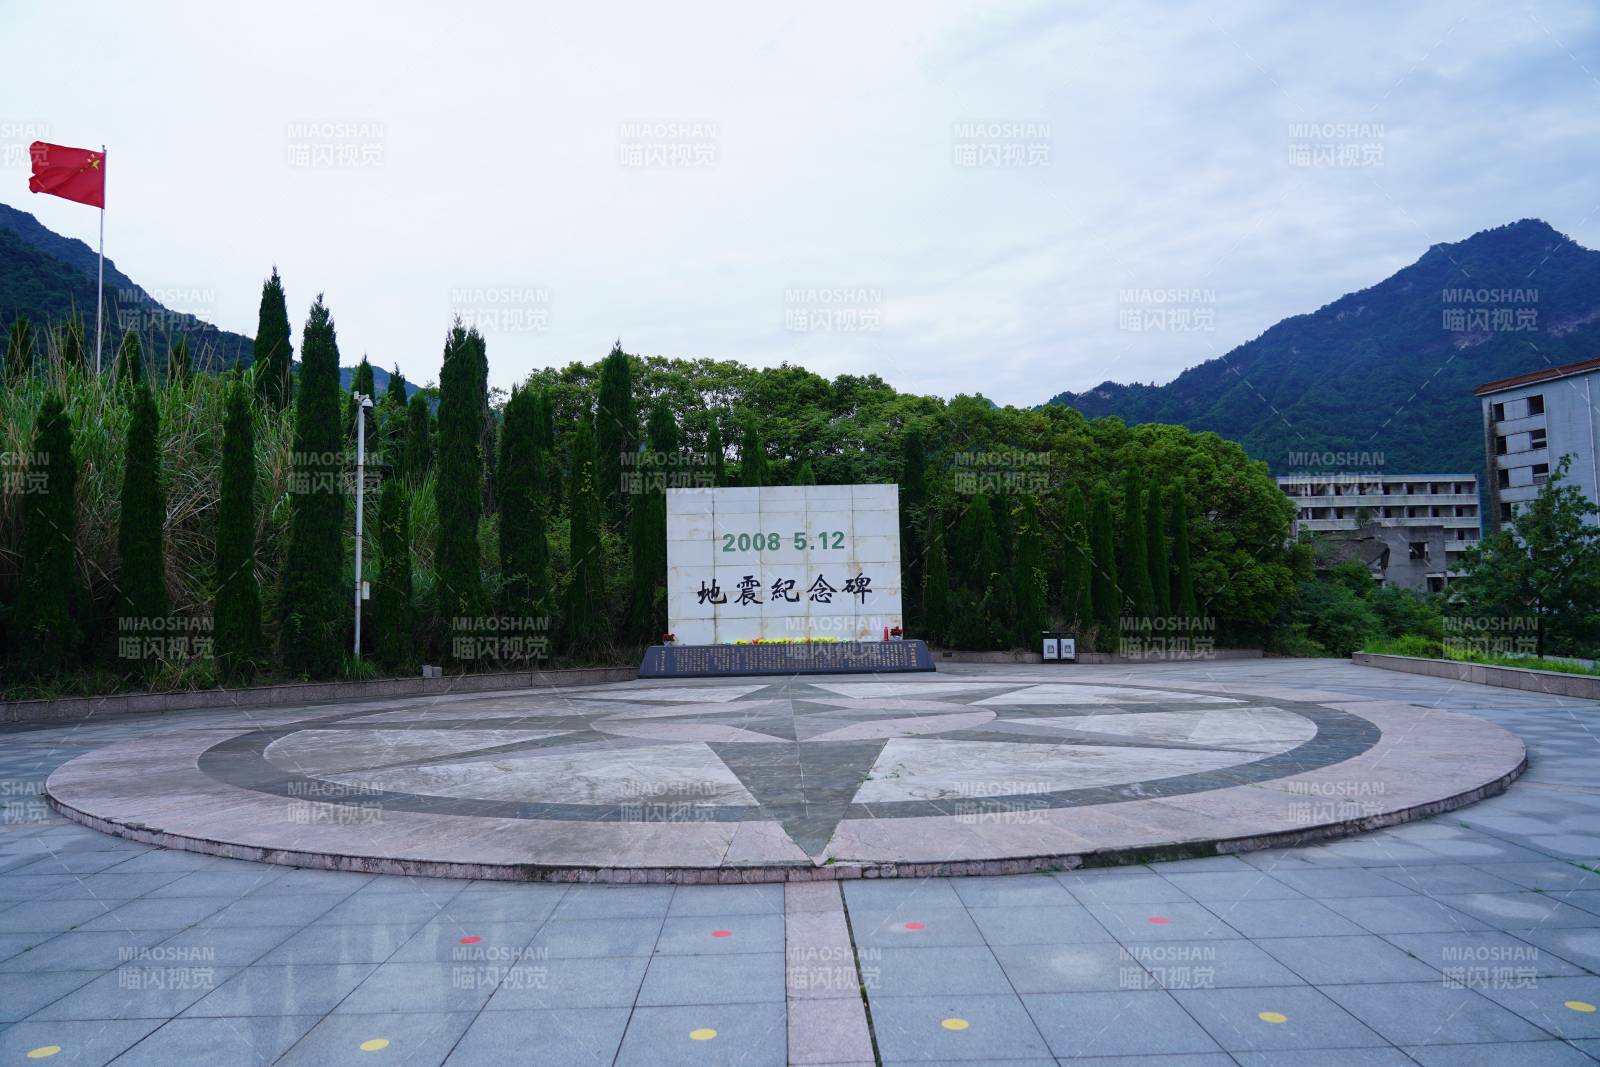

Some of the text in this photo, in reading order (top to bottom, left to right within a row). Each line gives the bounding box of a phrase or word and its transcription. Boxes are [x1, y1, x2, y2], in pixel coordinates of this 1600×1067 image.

[722, 531, 845, 552] 2008 5.12
[697, 572, 873, 606] 地震紀念碑
